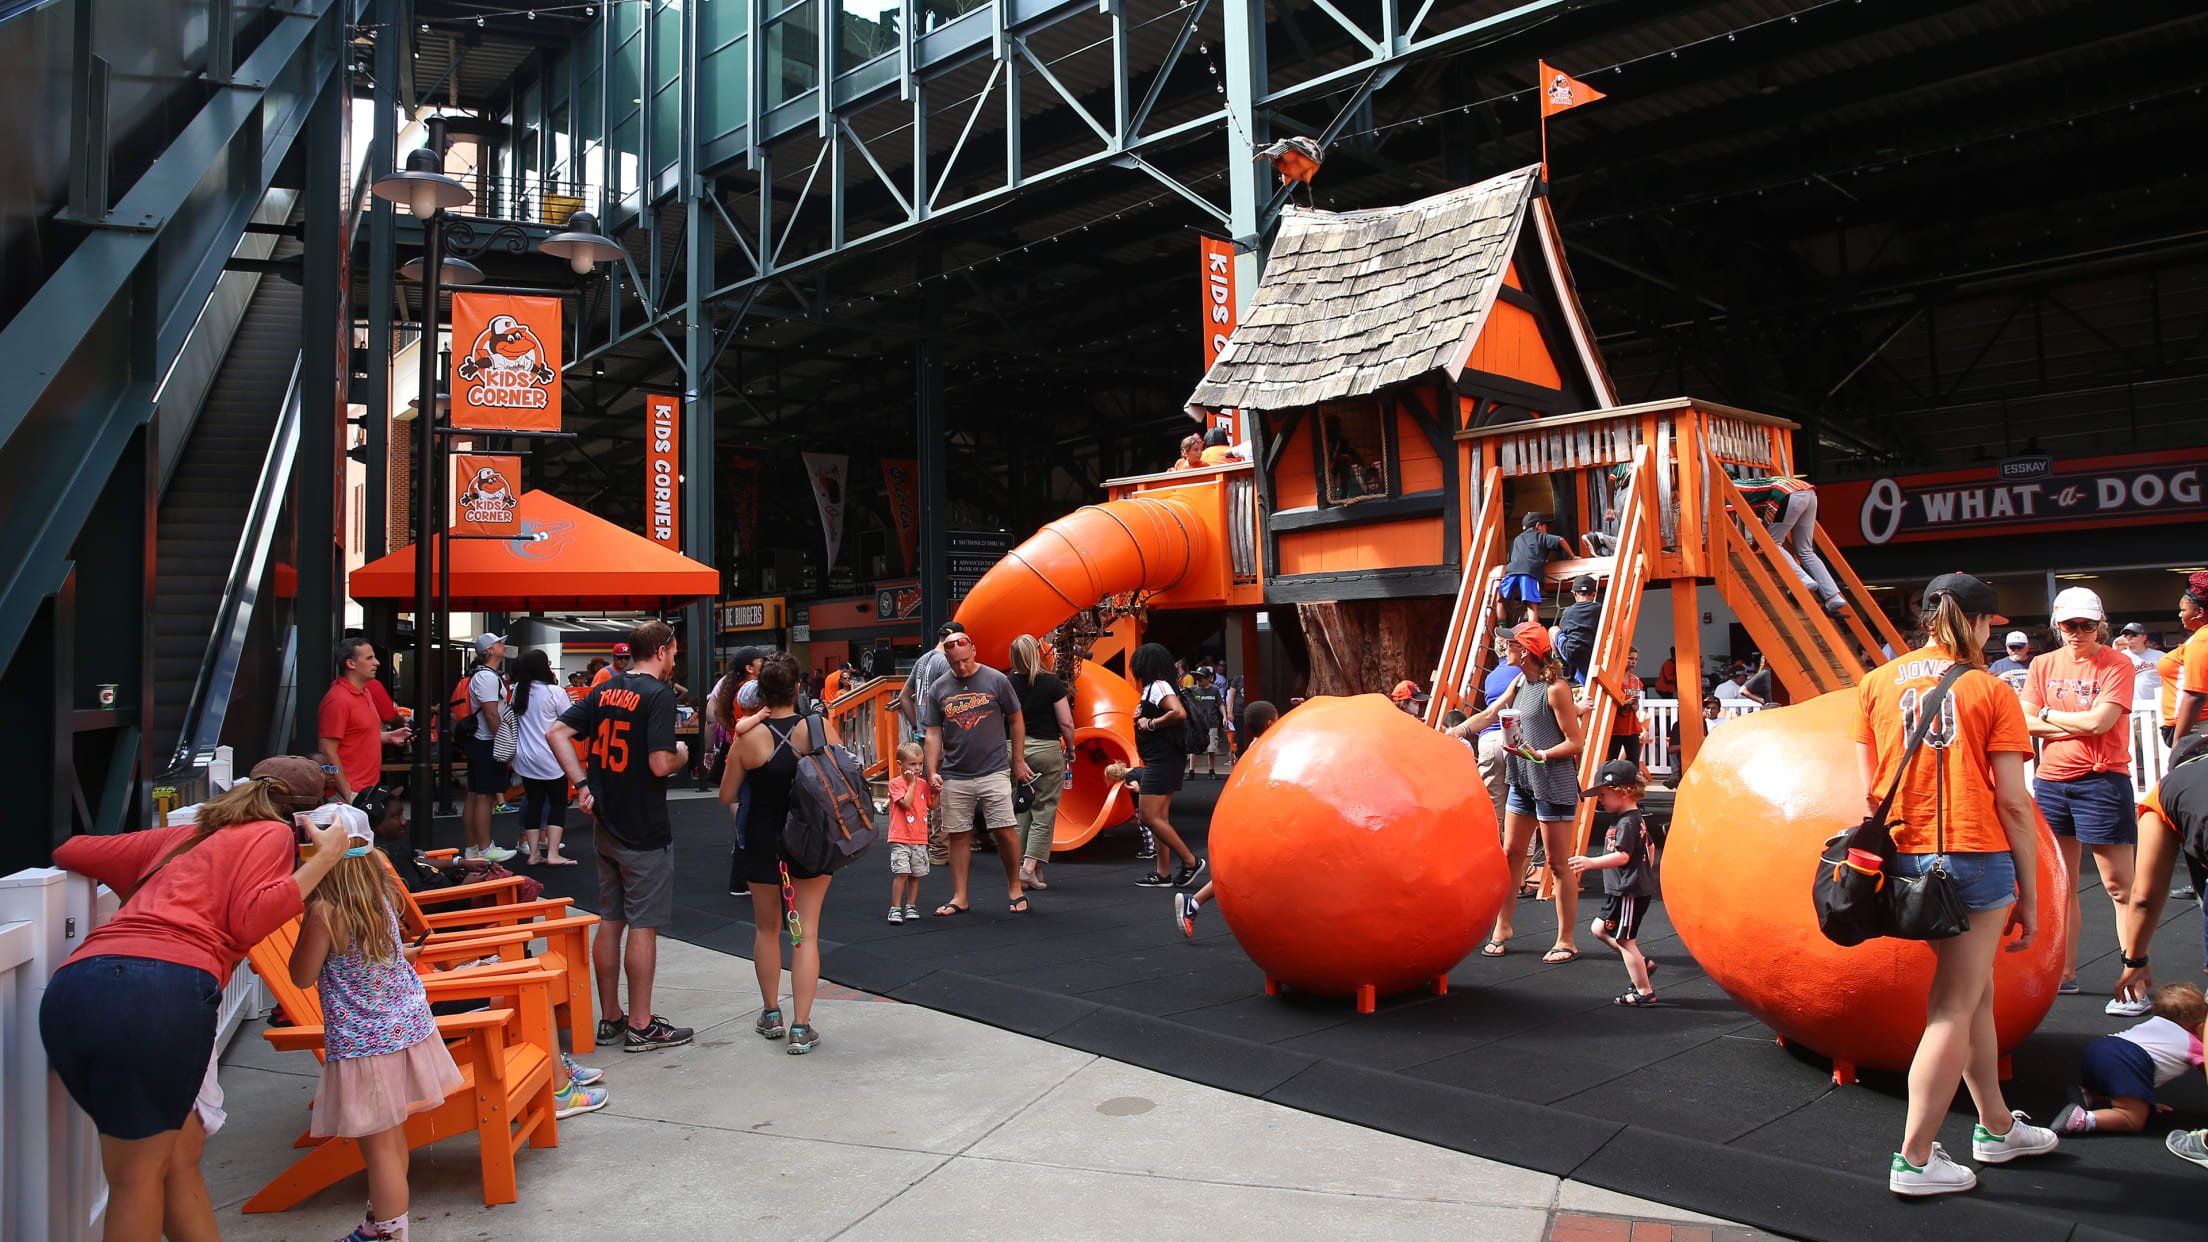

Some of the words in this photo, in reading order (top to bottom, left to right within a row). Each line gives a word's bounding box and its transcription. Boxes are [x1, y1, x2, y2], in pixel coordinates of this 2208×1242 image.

[1208, 252, 1229, 325] KIDS
[470, 388, 547, 407] CORNER
[654, 404, 672, 453] KIDS
[2004, 461, 2047, 475] ESSKAY
[654, 459, 672, 541] CORNER
[1861, 478, 1908, 544] O
[1921, 484, 2041, 522] WHAT
[2096, 469, 2202, 510] DOG
[467, 510, 511, 521] CORNER
[735, 604, 763, 625] BURGERS
[1894, 658, 1956, 685] JONE
[2135, 660, 2155, 672] oles
[944, 695, 990, 718] Orioles
[591, 717, 632, 773] 45
